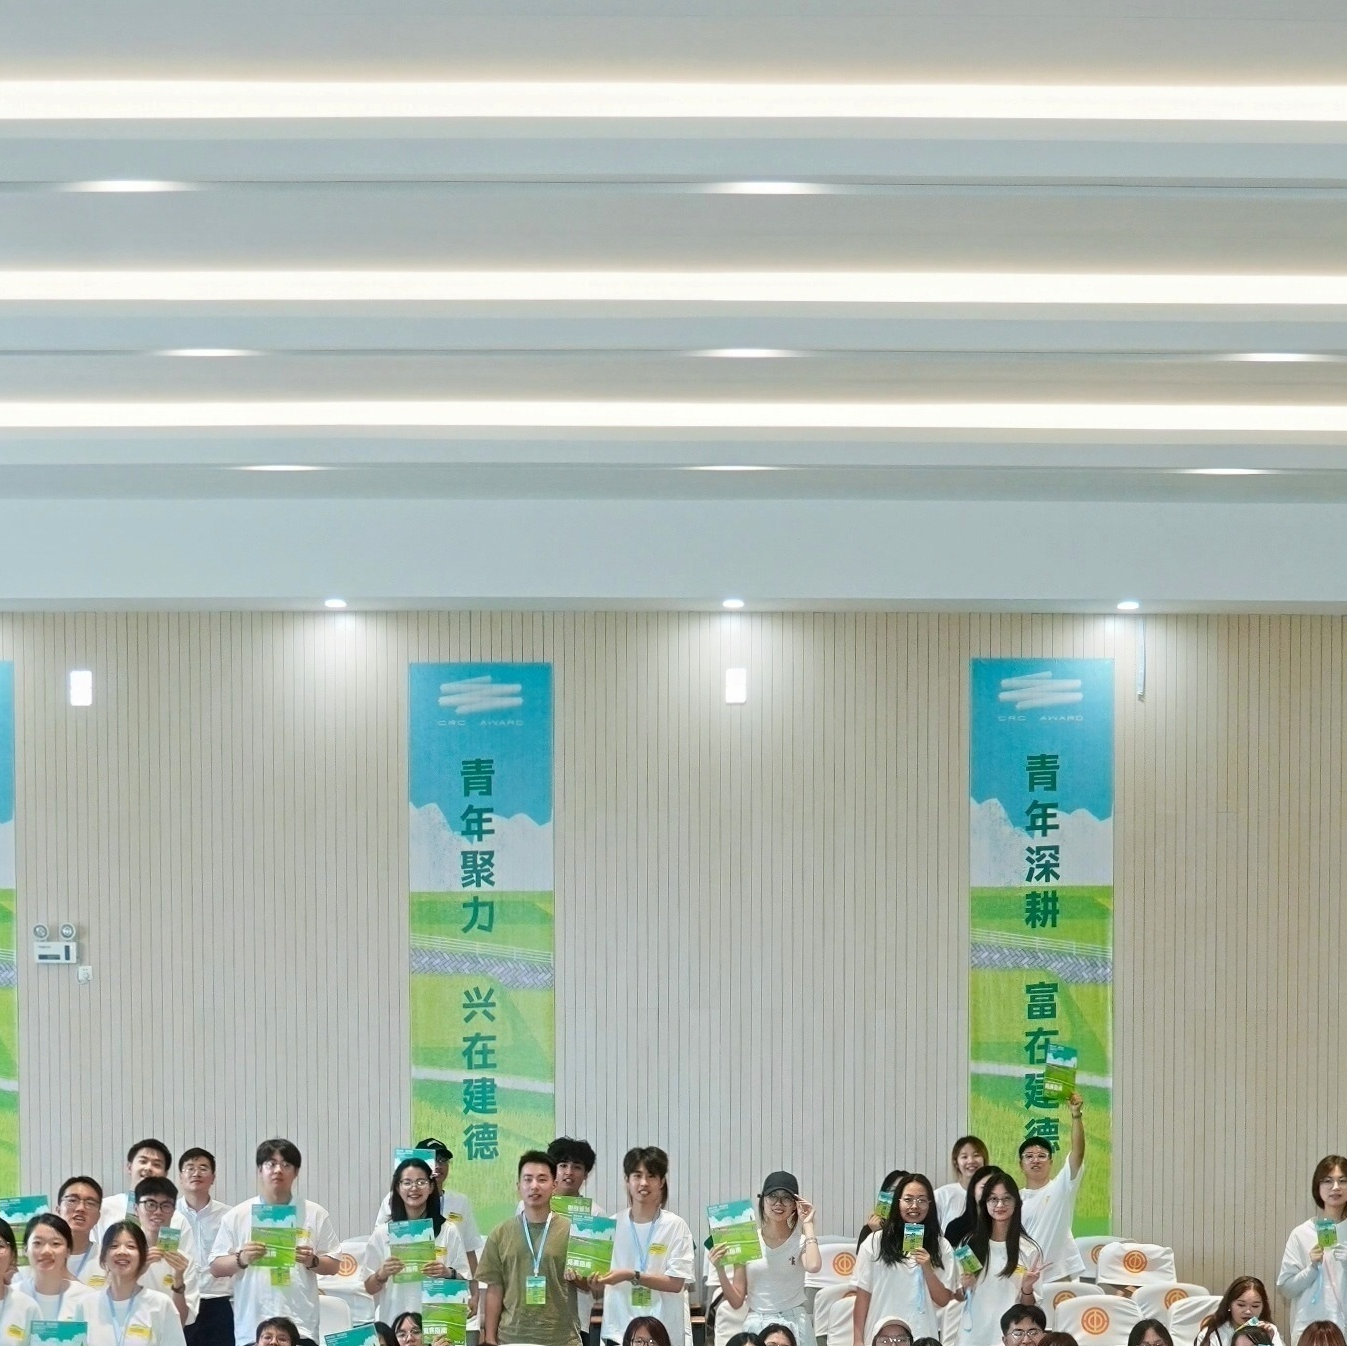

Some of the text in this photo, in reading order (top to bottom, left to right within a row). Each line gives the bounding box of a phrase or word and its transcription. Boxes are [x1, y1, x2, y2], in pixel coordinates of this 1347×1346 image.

[460, 758, 499, 1161] 青年聚力 兴在建德
[1024, 753, 1060, 929] 青年深耕
